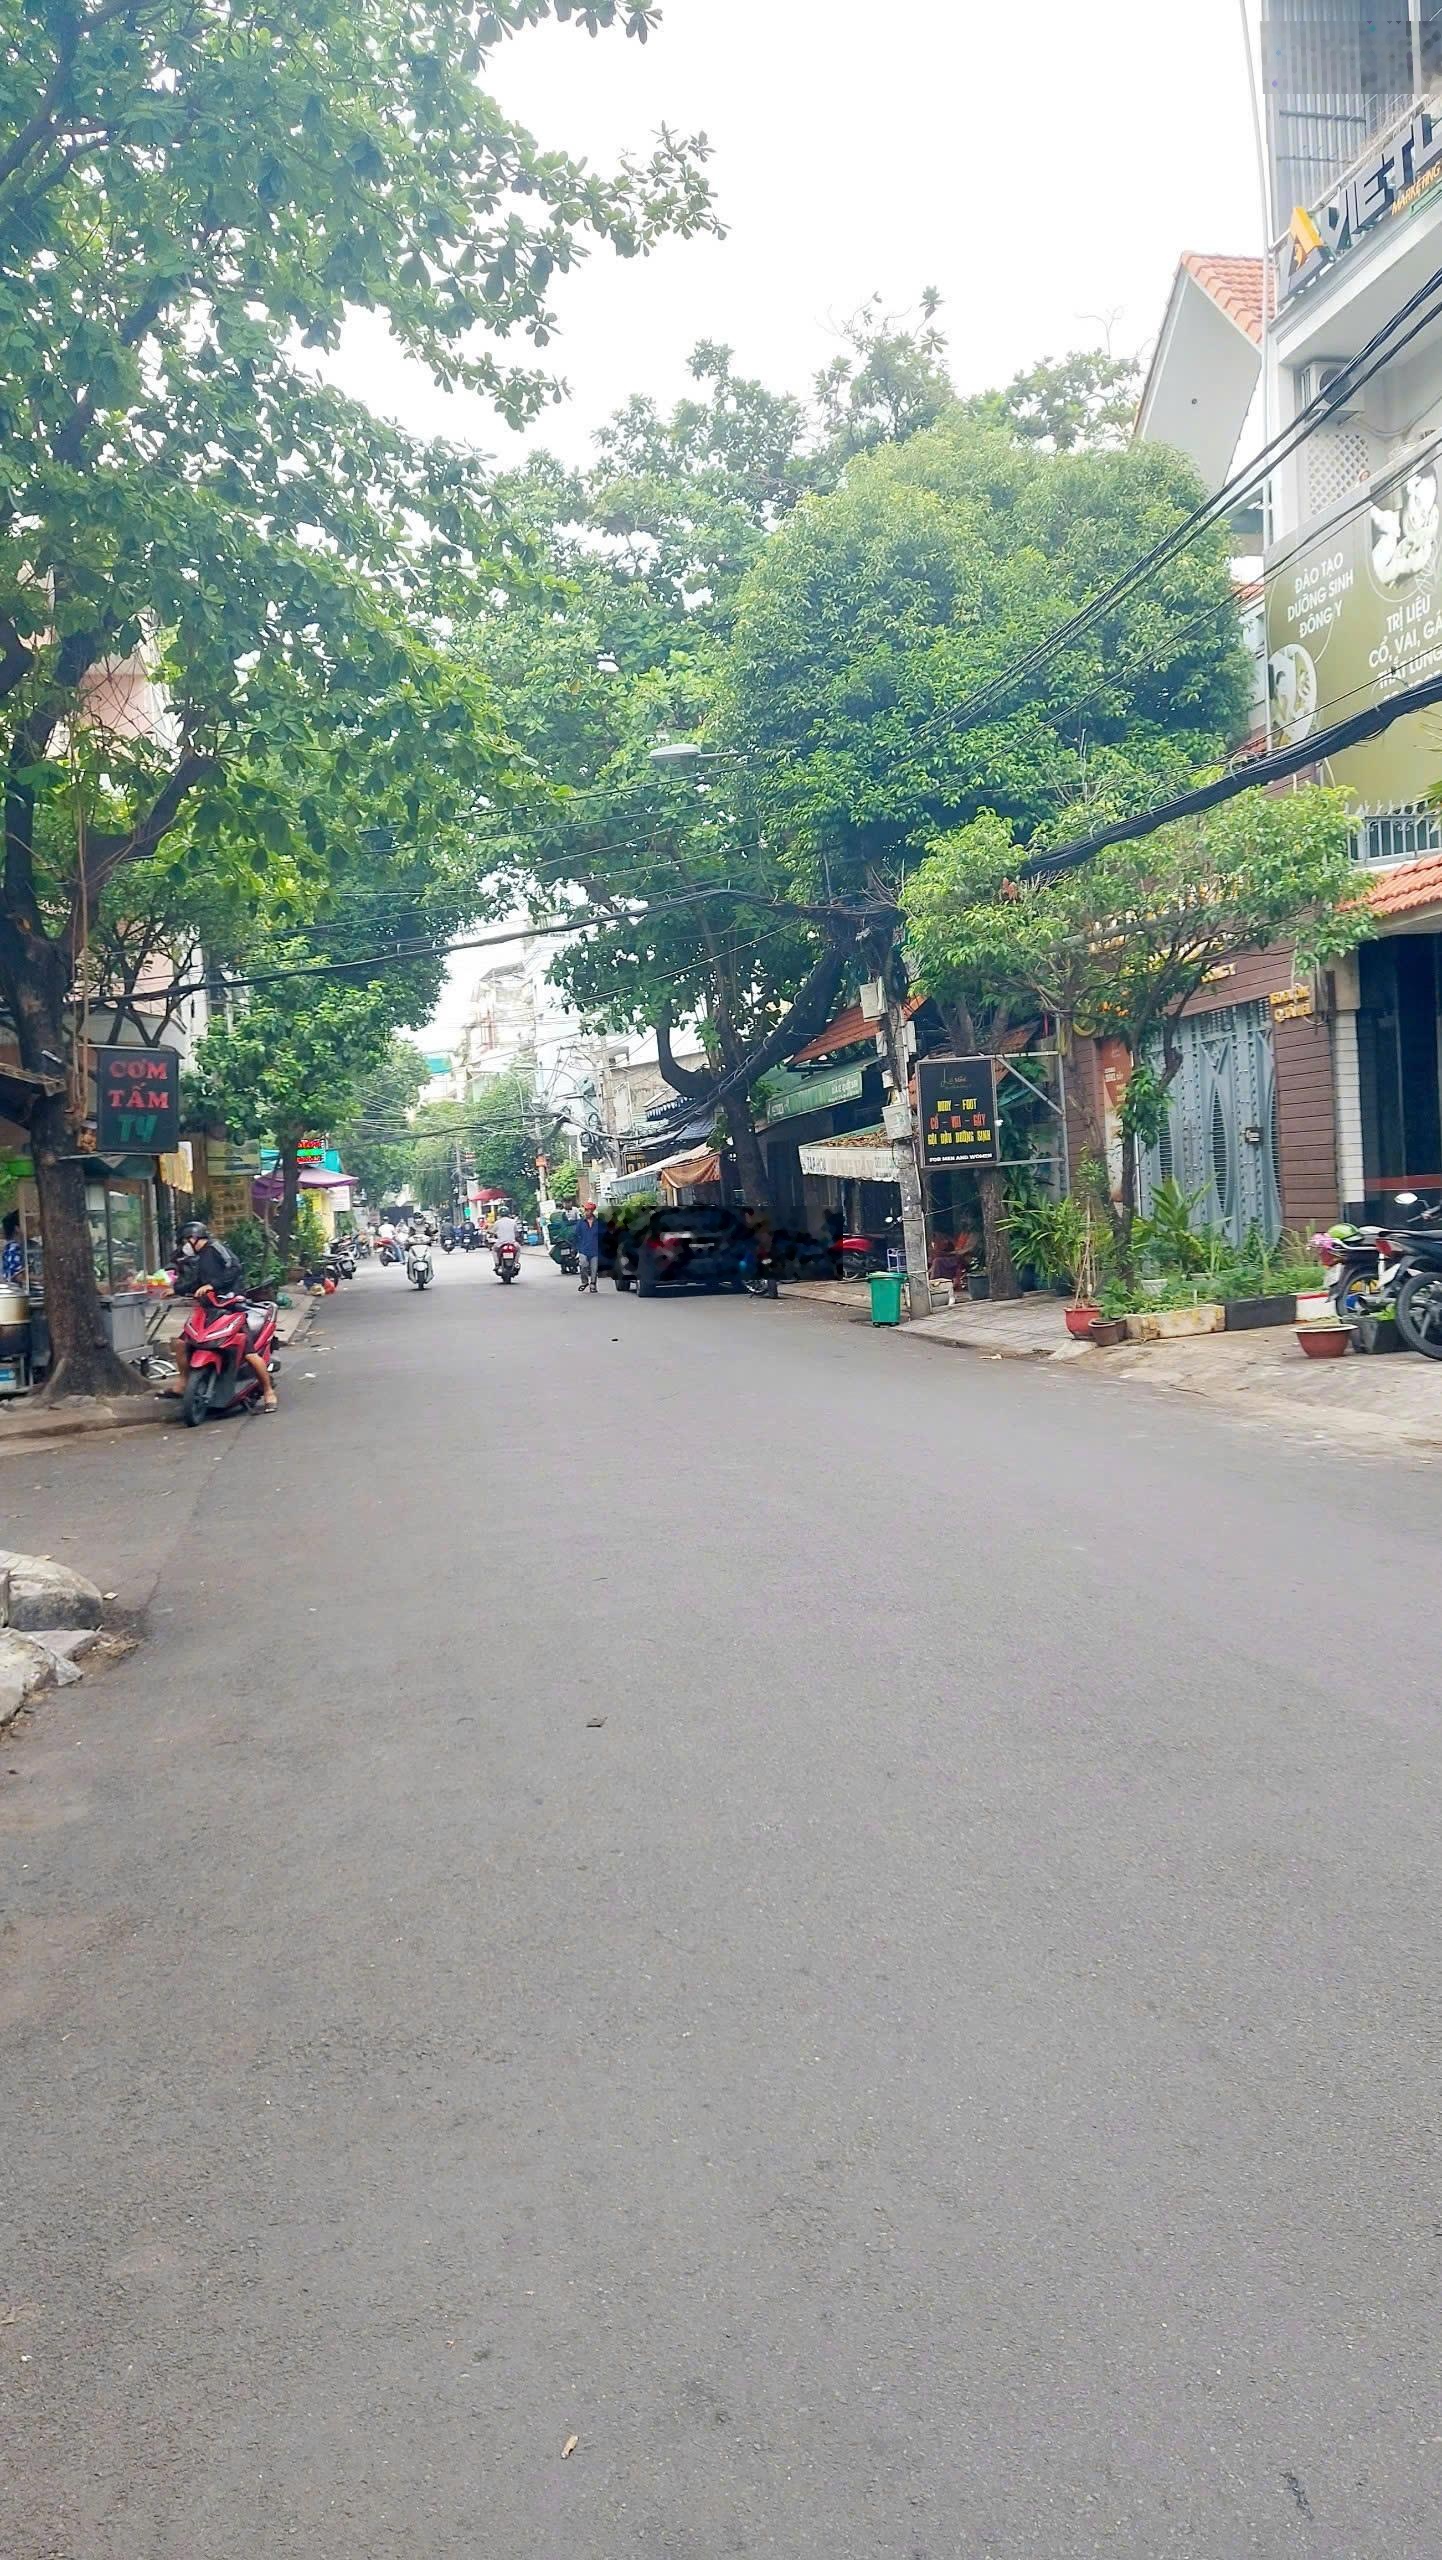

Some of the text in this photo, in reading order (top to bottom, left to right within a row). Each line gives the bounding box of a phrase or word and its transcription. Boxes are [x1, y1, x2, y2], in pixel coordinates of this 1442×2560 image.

[1321, 552, 1344, 577] TẠO
[1328, 569, 1354, 597] SINH
[1299, 600, 1342, 639] ĐÔNG Y
[1386, 594, 1431, 632] TRỊ LIỆU
[1368, 635, 1392, 668] CỔ,
[1394, 628, 1420, 655] VAI,
[110, 1059, 168, 1080] CƠM
[107, 1081, 169, 1110] TẤM
[962, 1099, 977, 1110] FOOT
